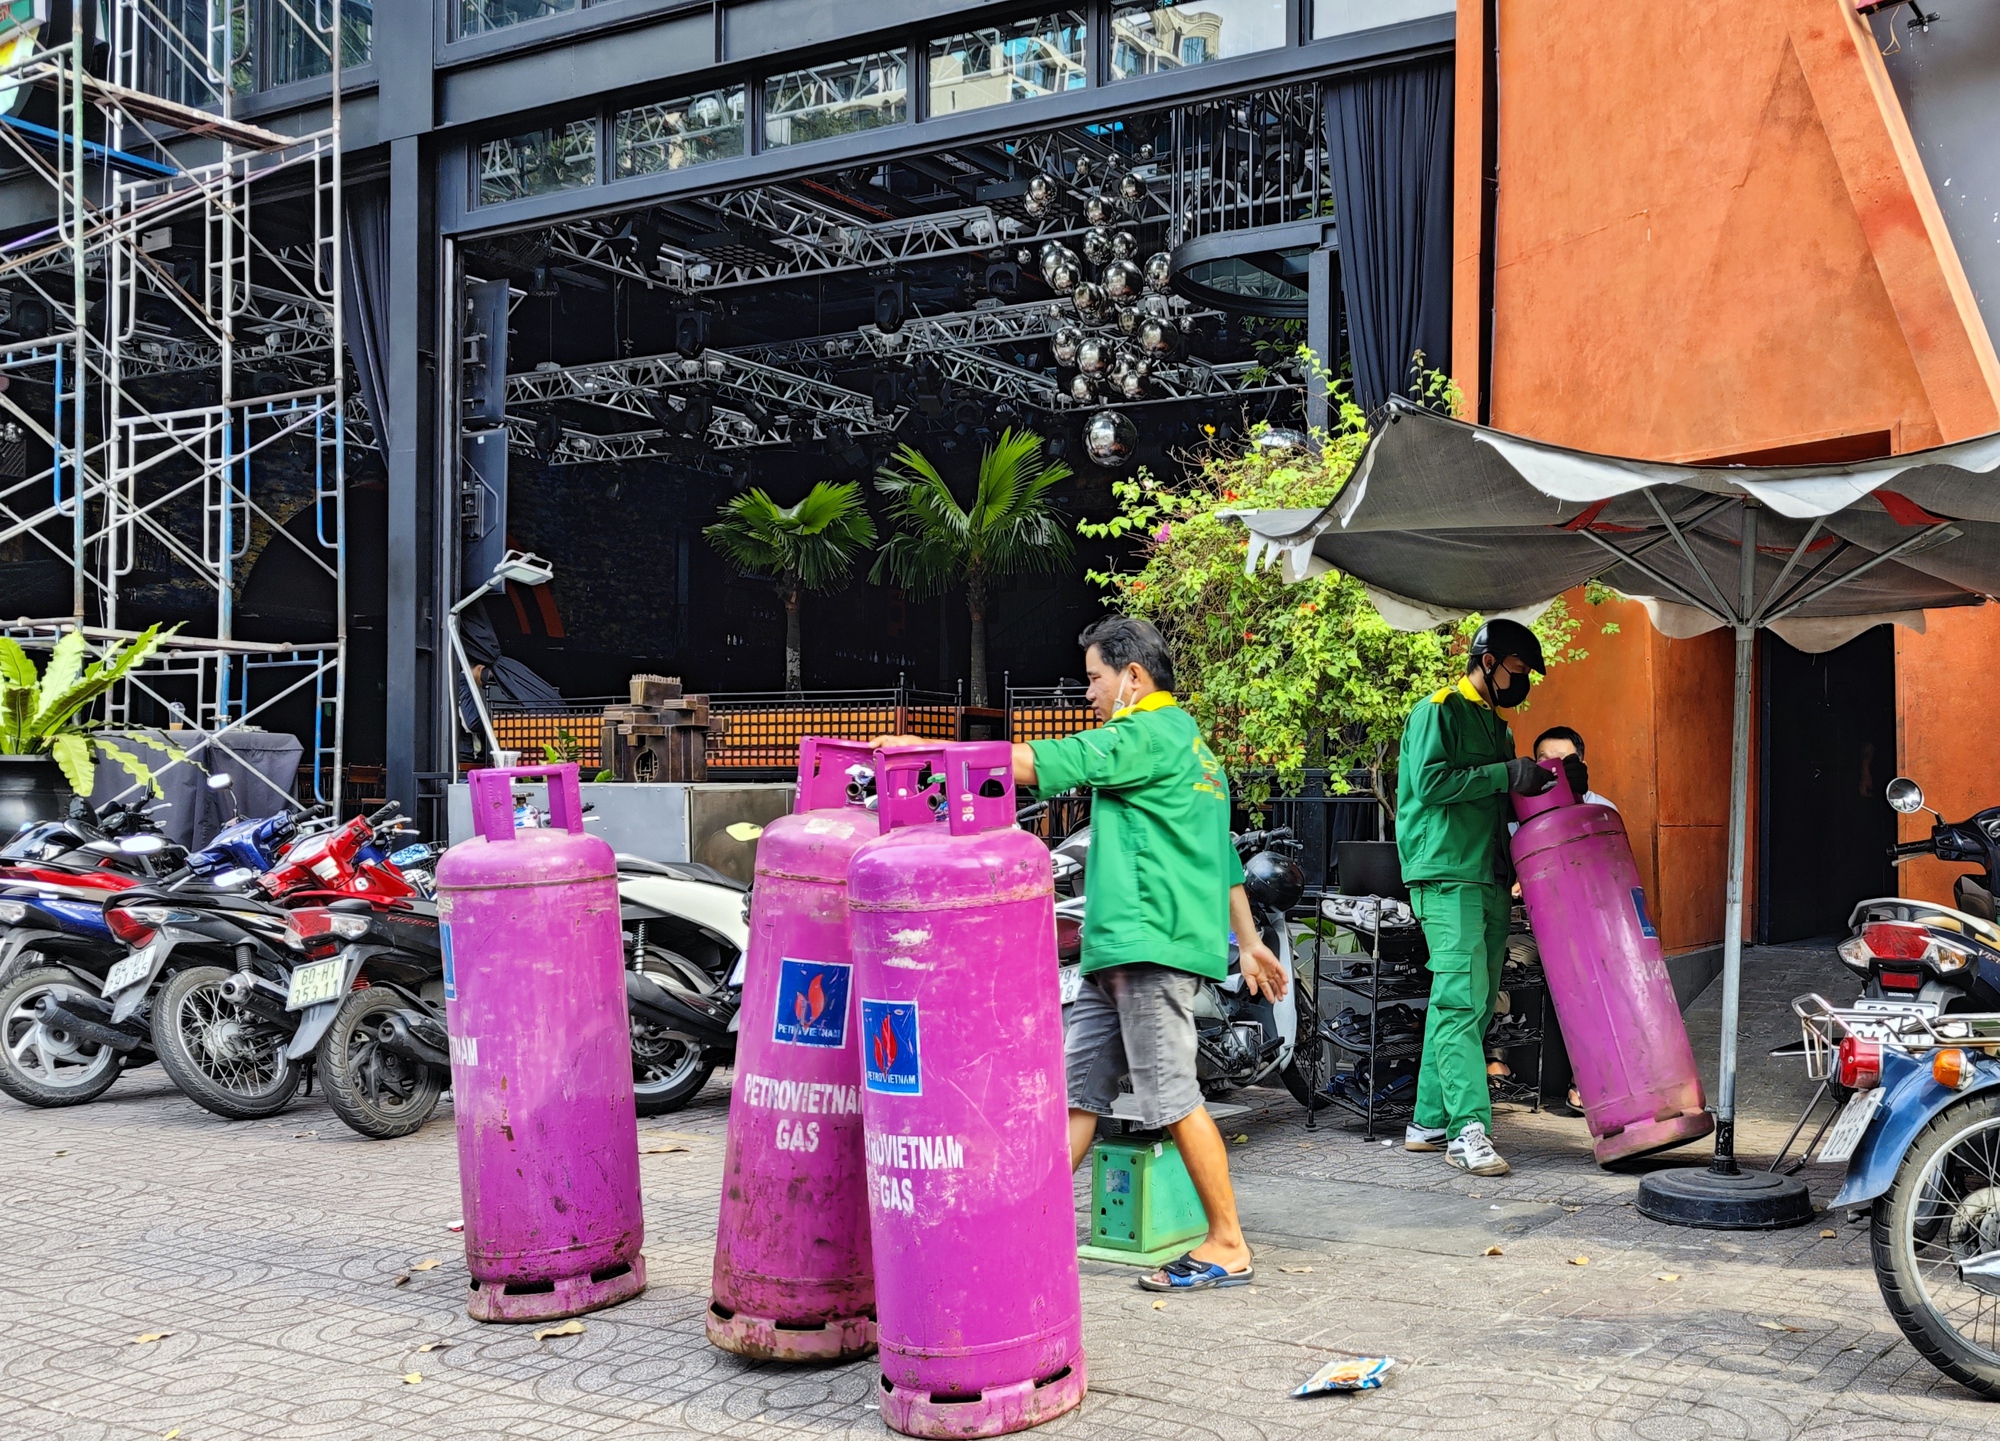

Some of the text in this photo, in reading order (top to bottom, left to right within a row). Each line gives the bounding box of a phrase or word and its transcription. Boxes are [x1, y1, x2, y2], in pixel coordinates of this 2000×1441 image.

[301, 962, 336, 986] 60-H1
[776, 1119, 820, 1153] GAS
[880, 1175, 914, 1212] GAS
